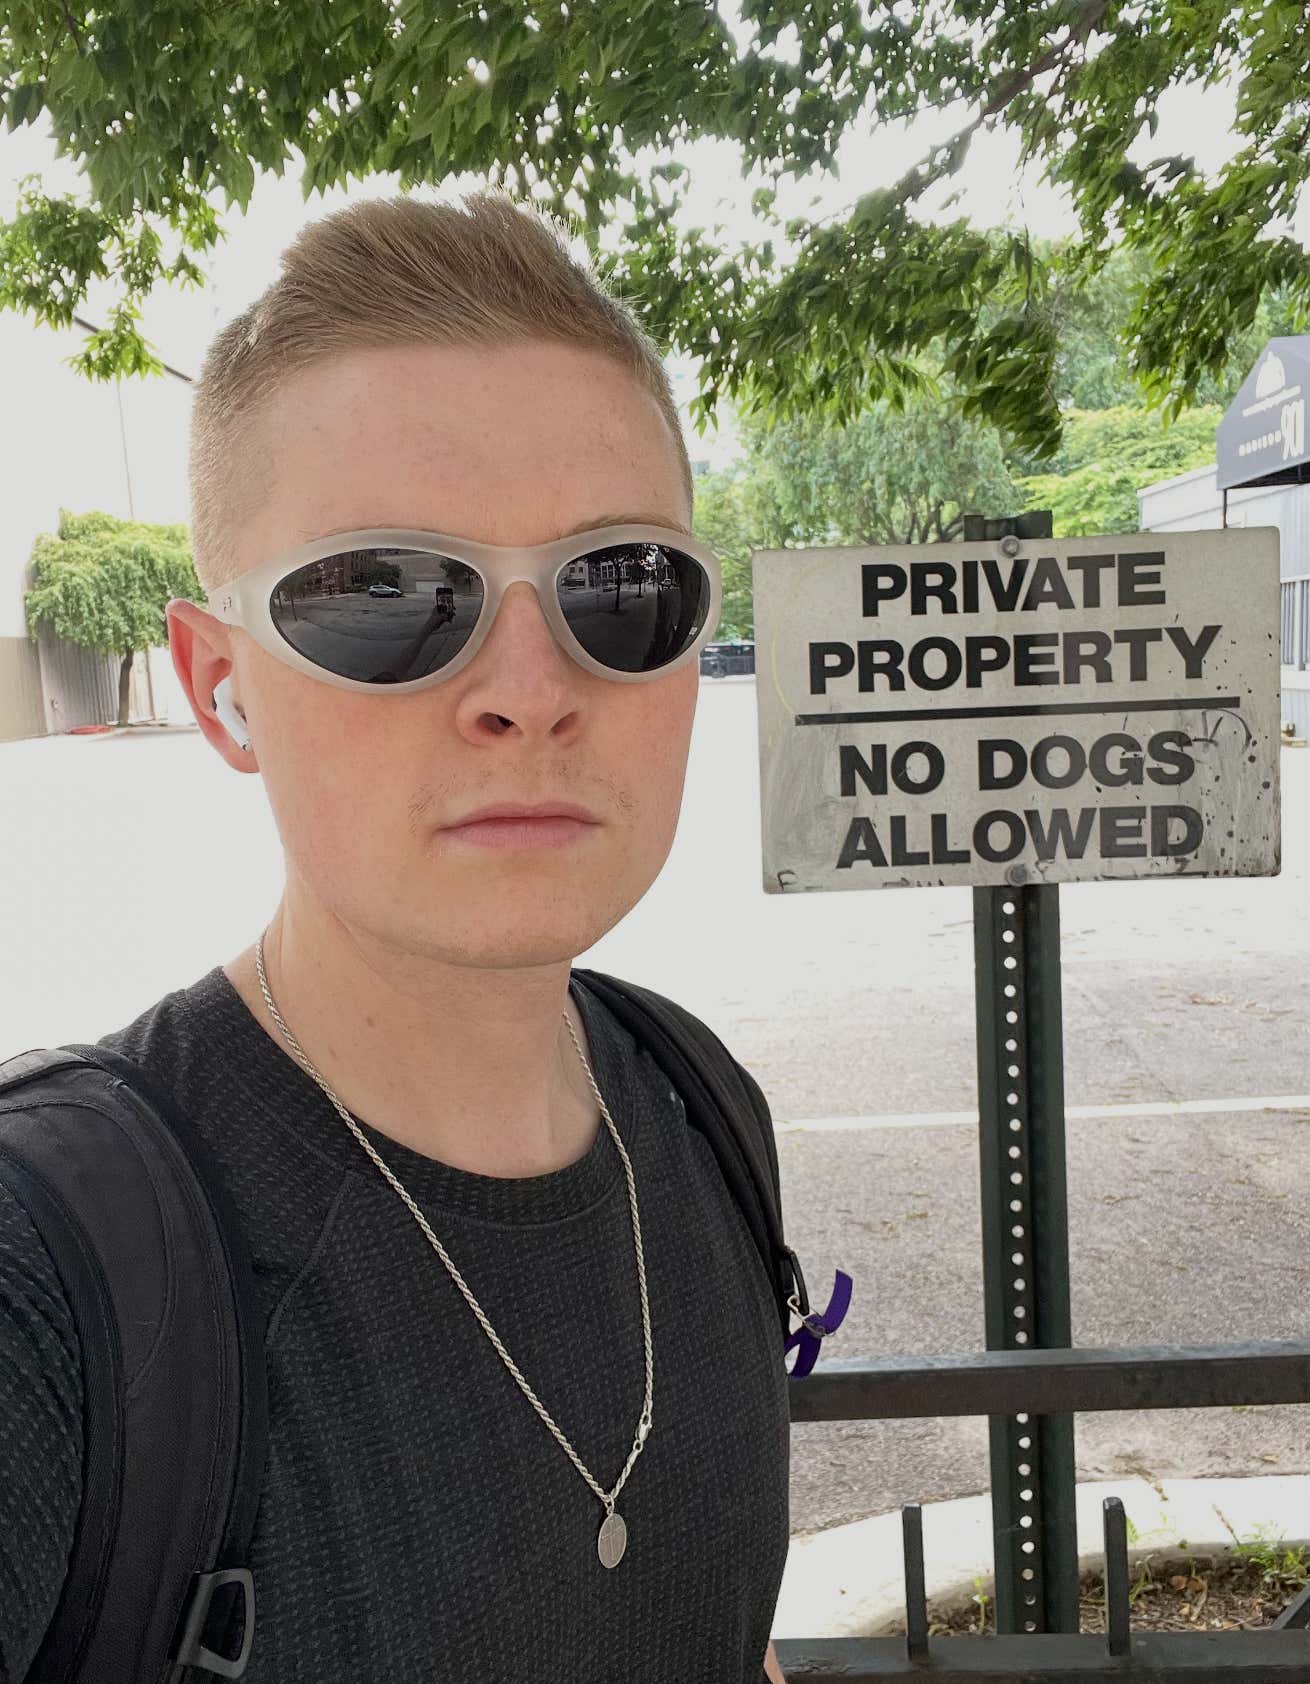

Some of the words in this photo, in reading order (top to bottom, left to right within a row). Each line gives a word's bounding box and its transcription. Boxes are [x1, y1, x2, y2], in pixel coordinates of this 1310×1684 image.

[861, 551, 1166, 617] PRIVATE
[808, 625, 1222, 695] PROPERTY
[839, 741, 945, 797] NO
[978, 731, 1195, 791] DOGS
[835, 805, 1204, 869] ALLOWED
